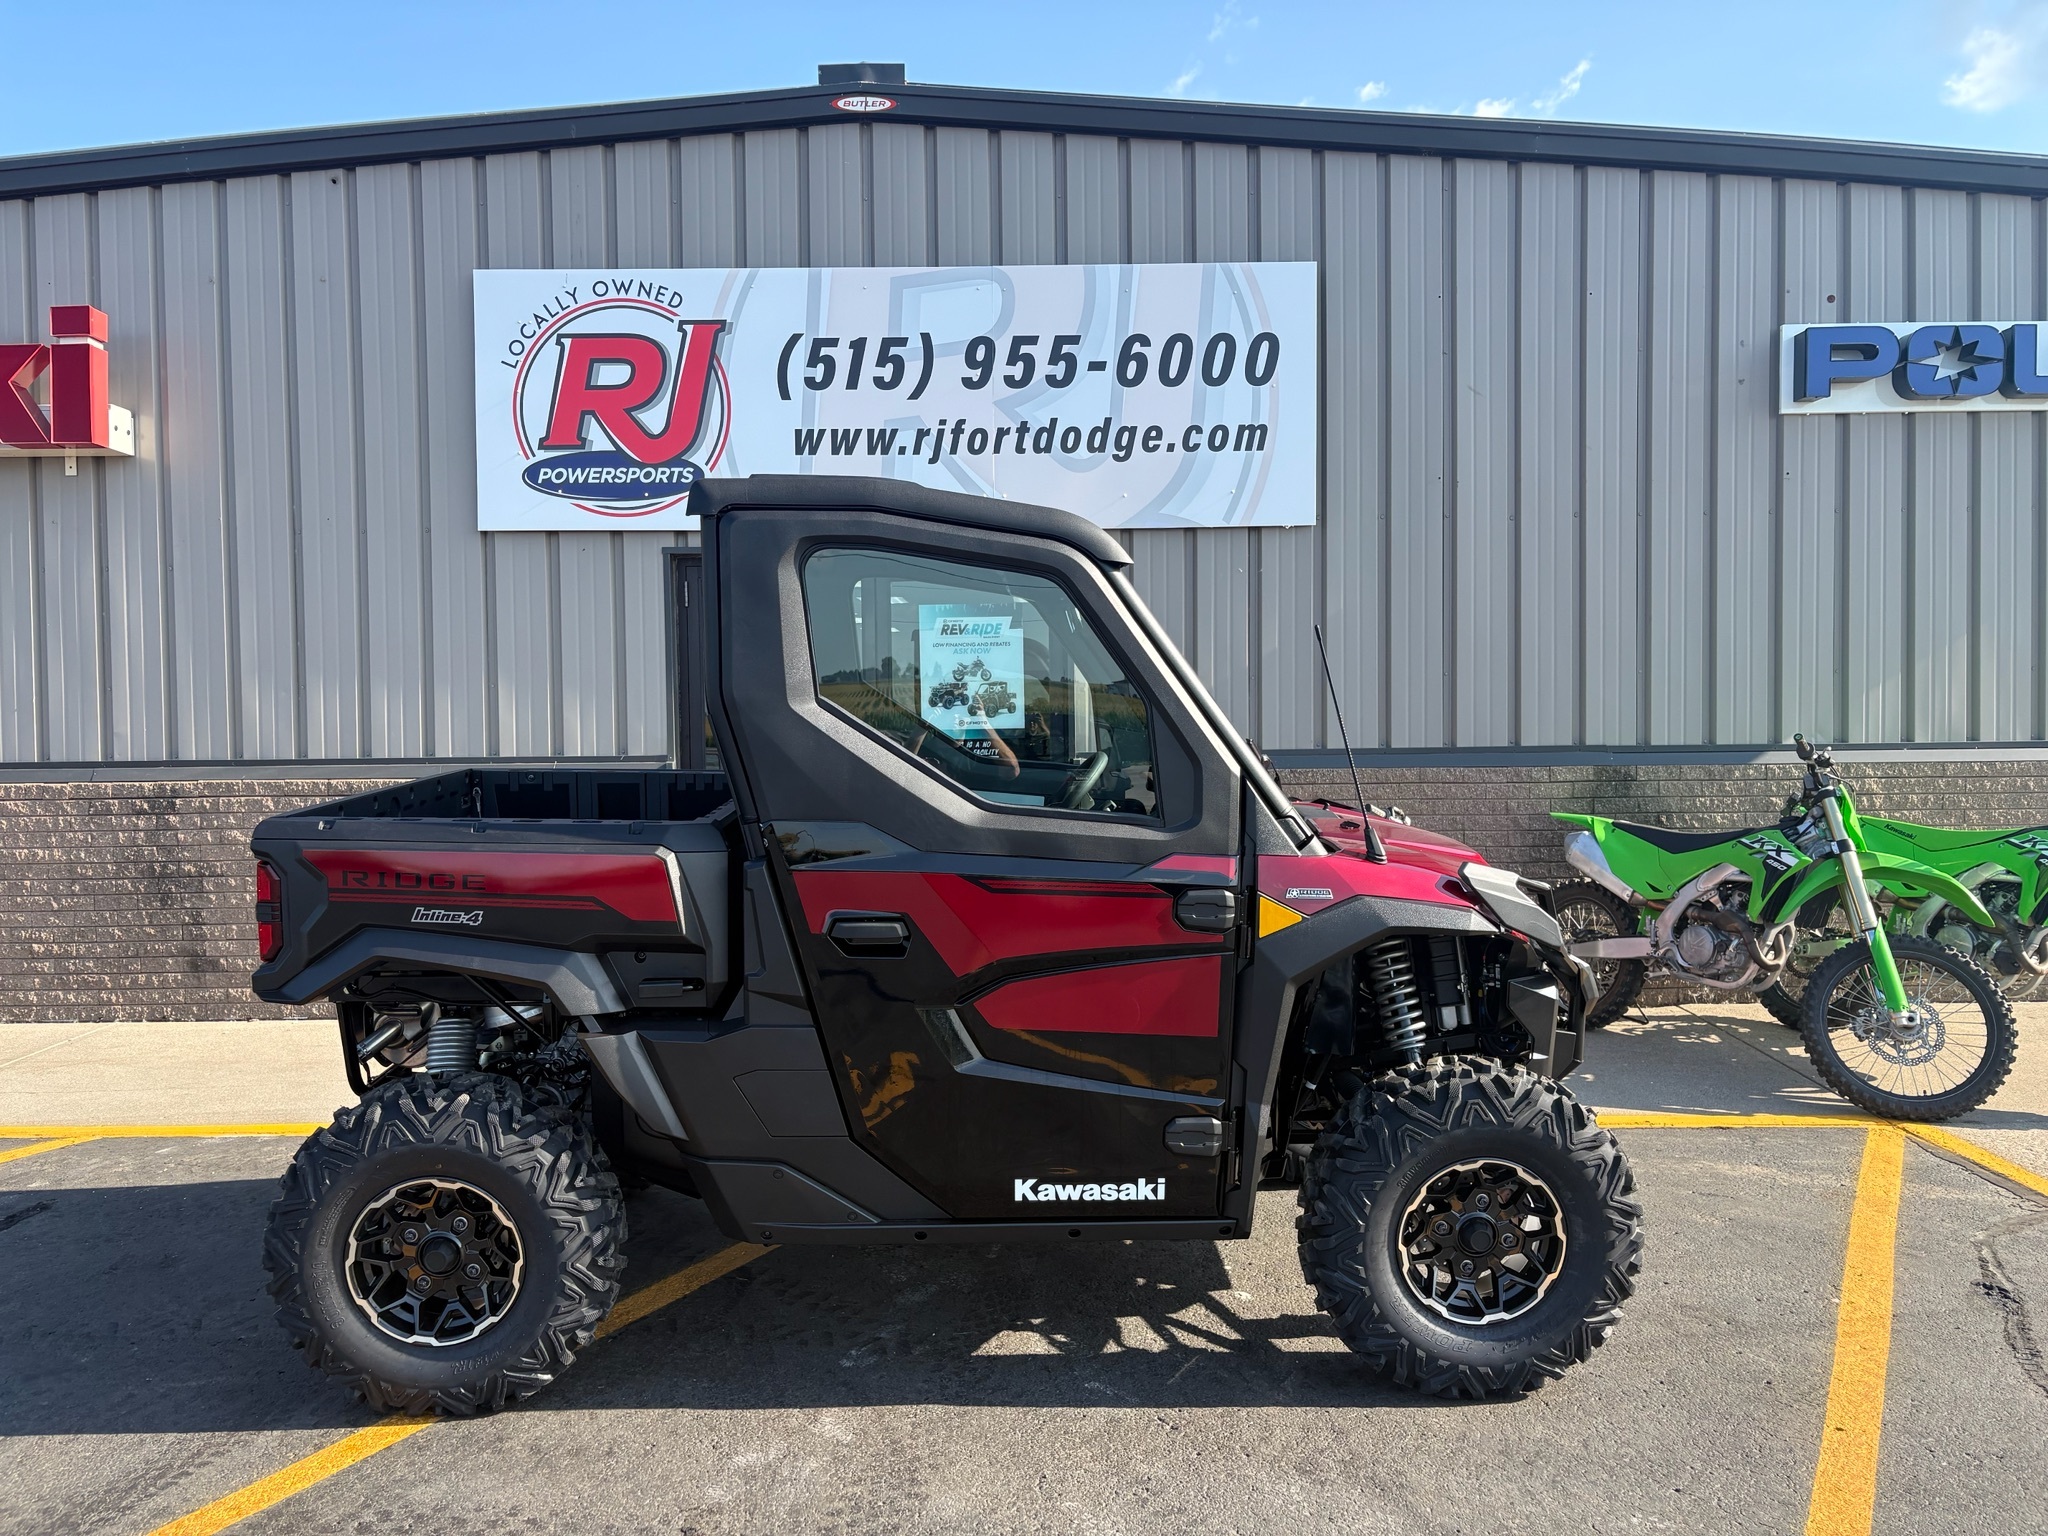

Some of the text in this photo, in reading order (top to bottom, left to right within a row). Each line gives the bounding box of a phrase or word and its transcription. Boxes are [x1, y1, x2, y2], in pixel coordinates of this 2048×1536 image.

[842, 100, 887, 108] BUTLER
[501, 278, 684, 369] LOCALLY OWNED
[777, 331, 1281, 401] (515) 955-6000
[537, 319, 730, 466] RJ
[794, 416, 1269, 465] www.rjfortdodge.com
[537, 466, 695, 484] POWERSPORTS
[1884, 823, 1918, 840] Kawasaki
[1765, 858, 1789, 871] 450
[341, 870, 487, 891] RIDGE
[411, 906, 484, 926] Inline-4
[1014, 1177, 1166, 1202] Kawasaki
